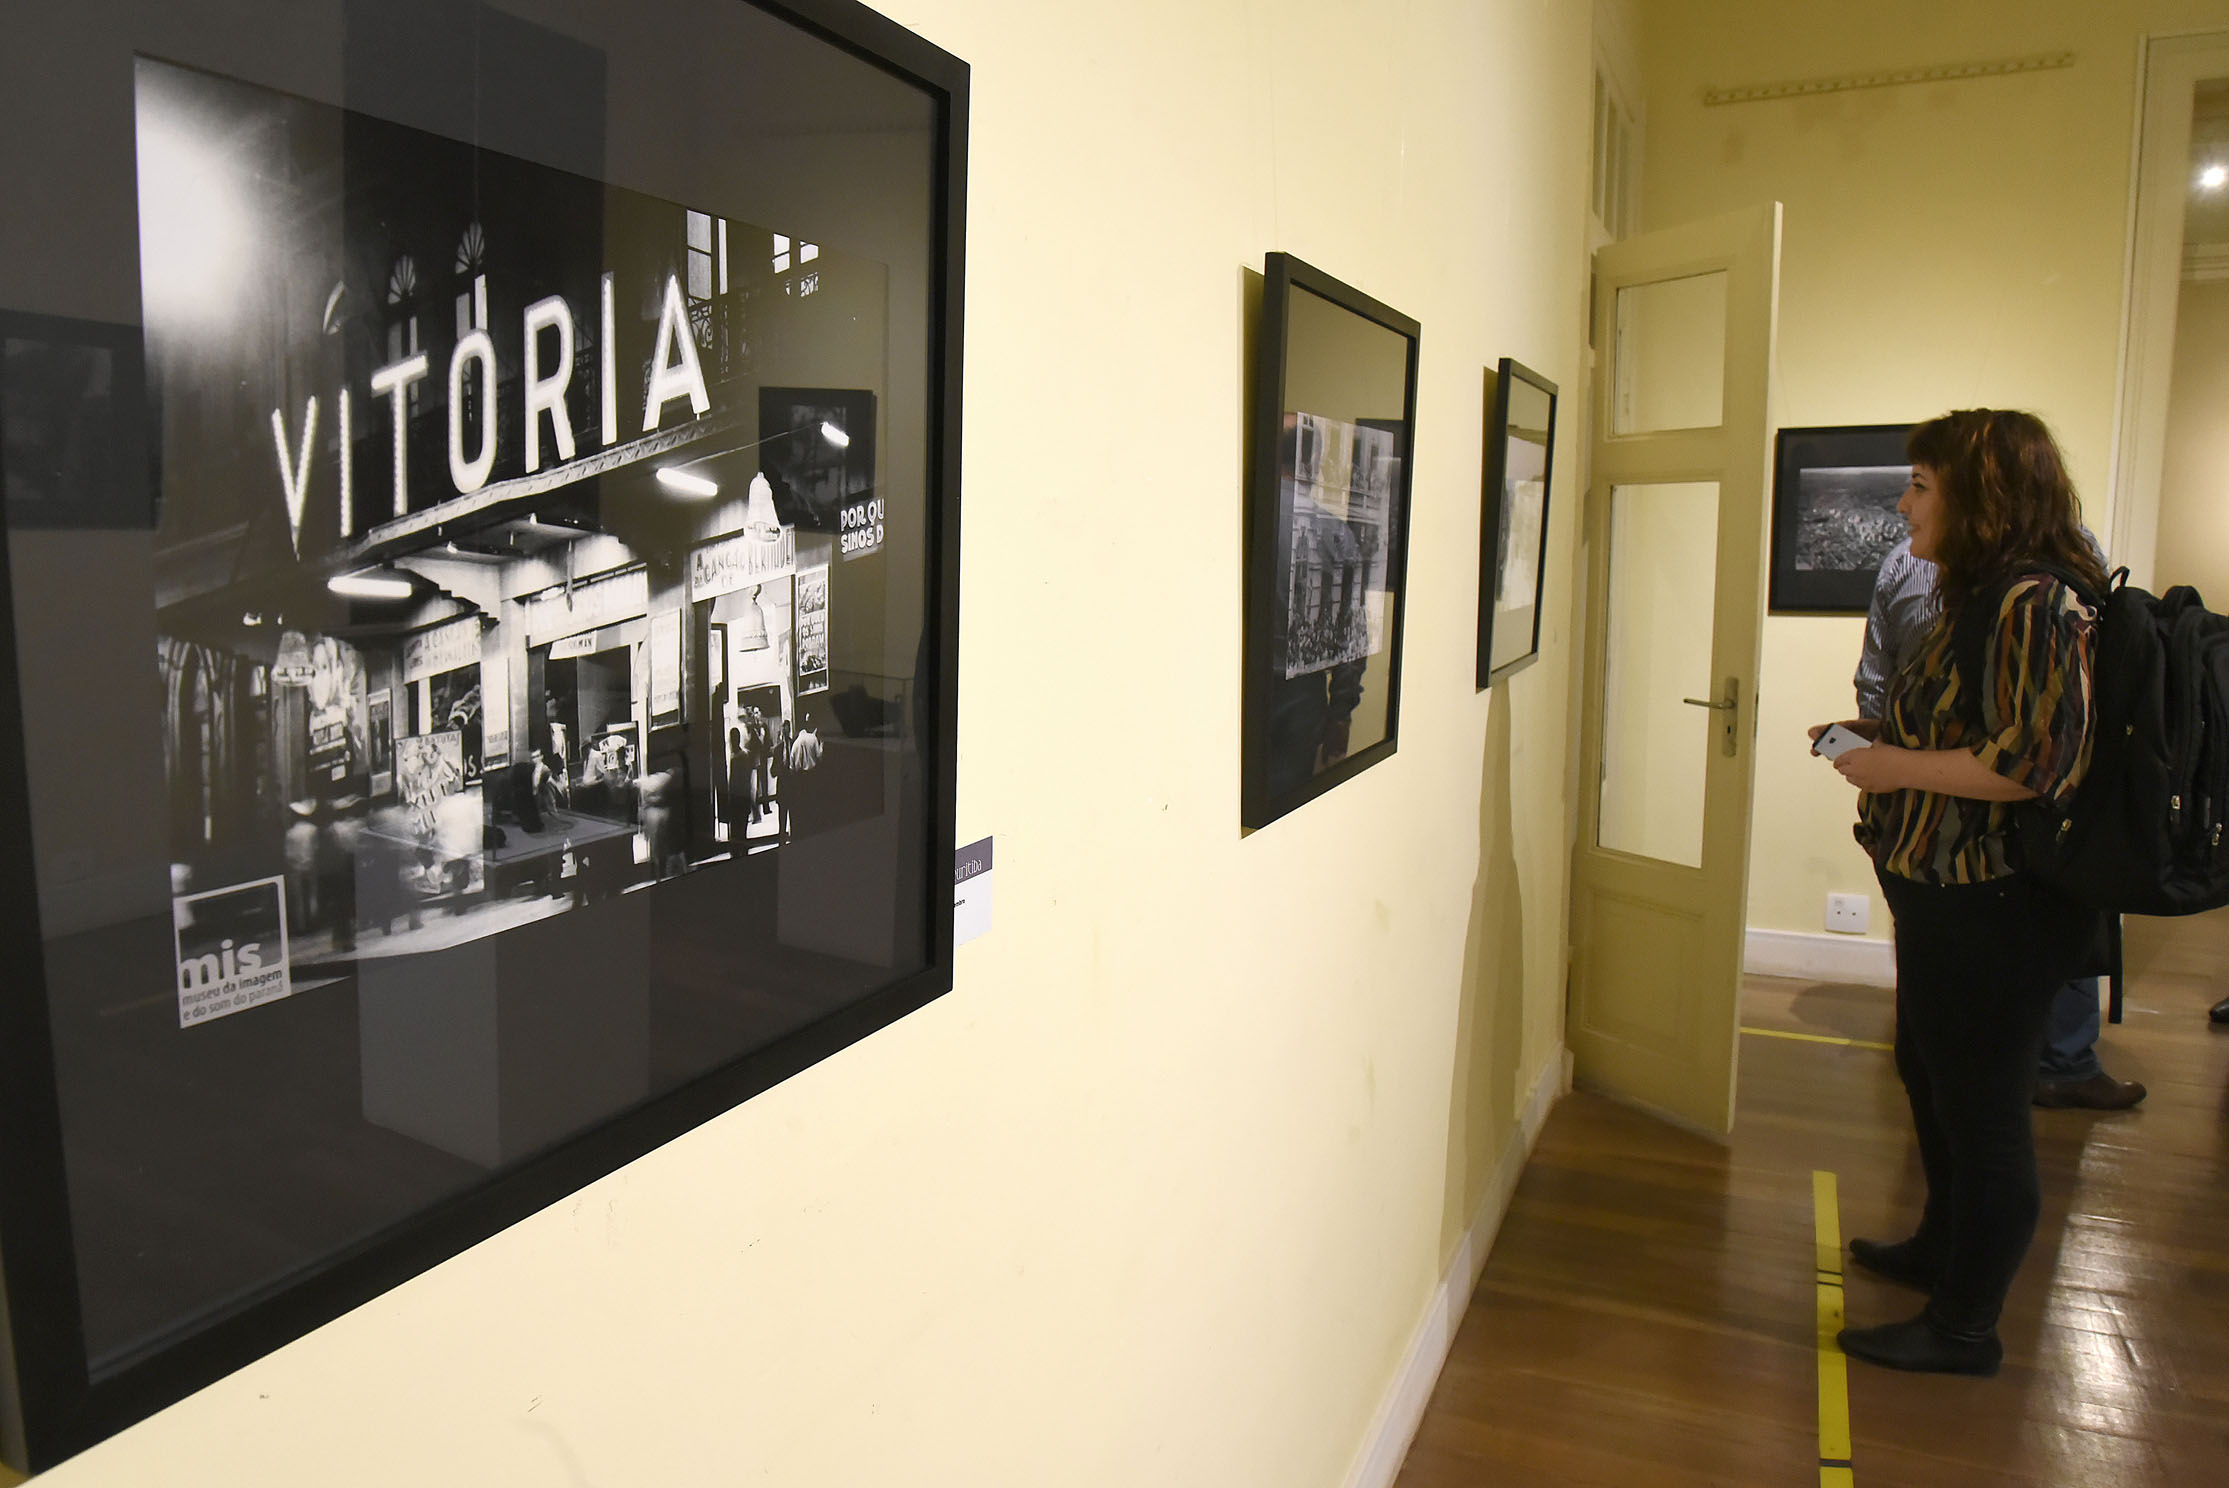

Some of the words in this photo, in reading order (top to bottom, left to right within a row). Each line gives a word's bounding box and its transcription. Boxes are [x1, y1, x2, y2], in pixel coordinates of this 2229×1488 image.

[841, 505, 867, 532] POR
[841, 527, 875, 554] SINOS
[180, 939, 262, 990] mis
[182, 987, 220, 1006] museu
[222, 982, 236, 994] da
[239, 970, 283, 989] imagem
[183, 1010, 190, 1020] e
[192, 1005, 206, 1018] do
[209, 999, 231, 1013] som
[233, 993, 247, 1006] do
